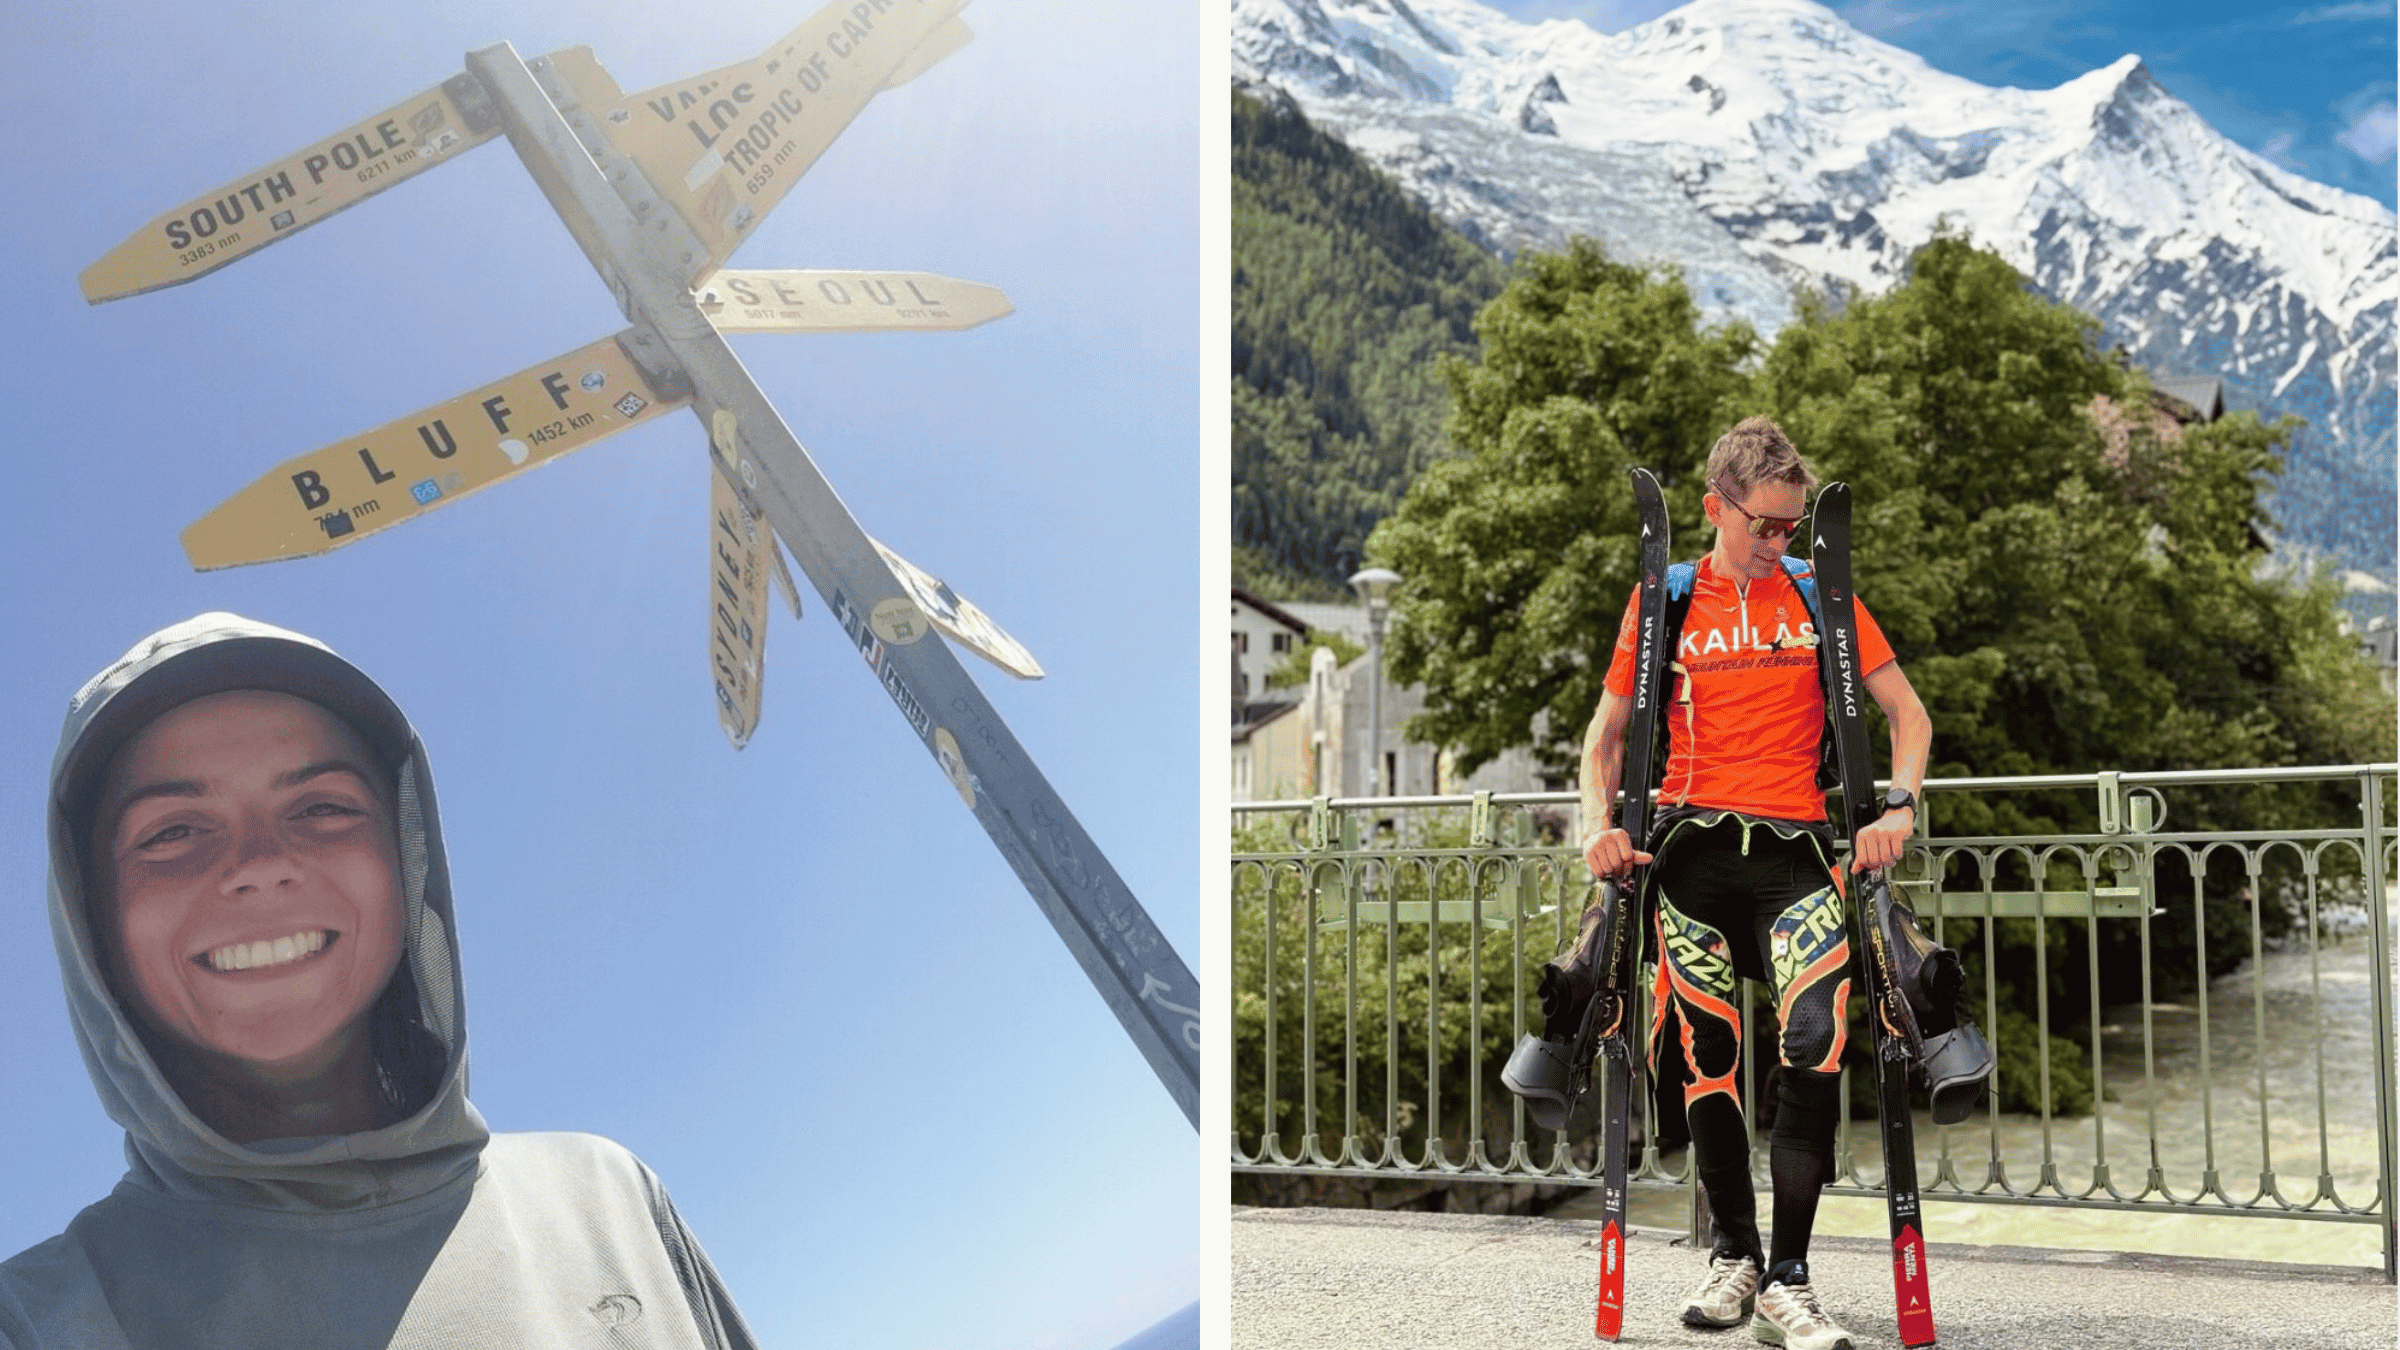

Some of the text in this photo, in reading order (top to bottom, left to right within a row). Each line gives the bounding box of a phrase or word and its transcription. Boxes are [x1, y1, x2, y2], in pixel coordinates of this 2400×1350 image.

[722, 88, 803, 177] TROPIC
[797, 51, 830, 94] OF
[164, 118, 408, 251] SOUTH POLE
[356, 146, 418, 184] 6211 km
[746, 139, 798, 195] 659 nm
[179, 231, 242, 267] 3383 nm
[726, 278, 942, 307] SEOUL
[743, 308, 776, 320] 5017
[291, 371, 571, 512] BLUFF
[527, 409, 595, 448] 1452 km
[352, 499, 380, 518] nm
[716, 509, 741, 689] SYDNEY
[1638, 616, 1654, 709] DYNASTAR
[1679, 621, 1816, 659] KAILAS
[1836, 627, 1857, 717] DYNASTAR
